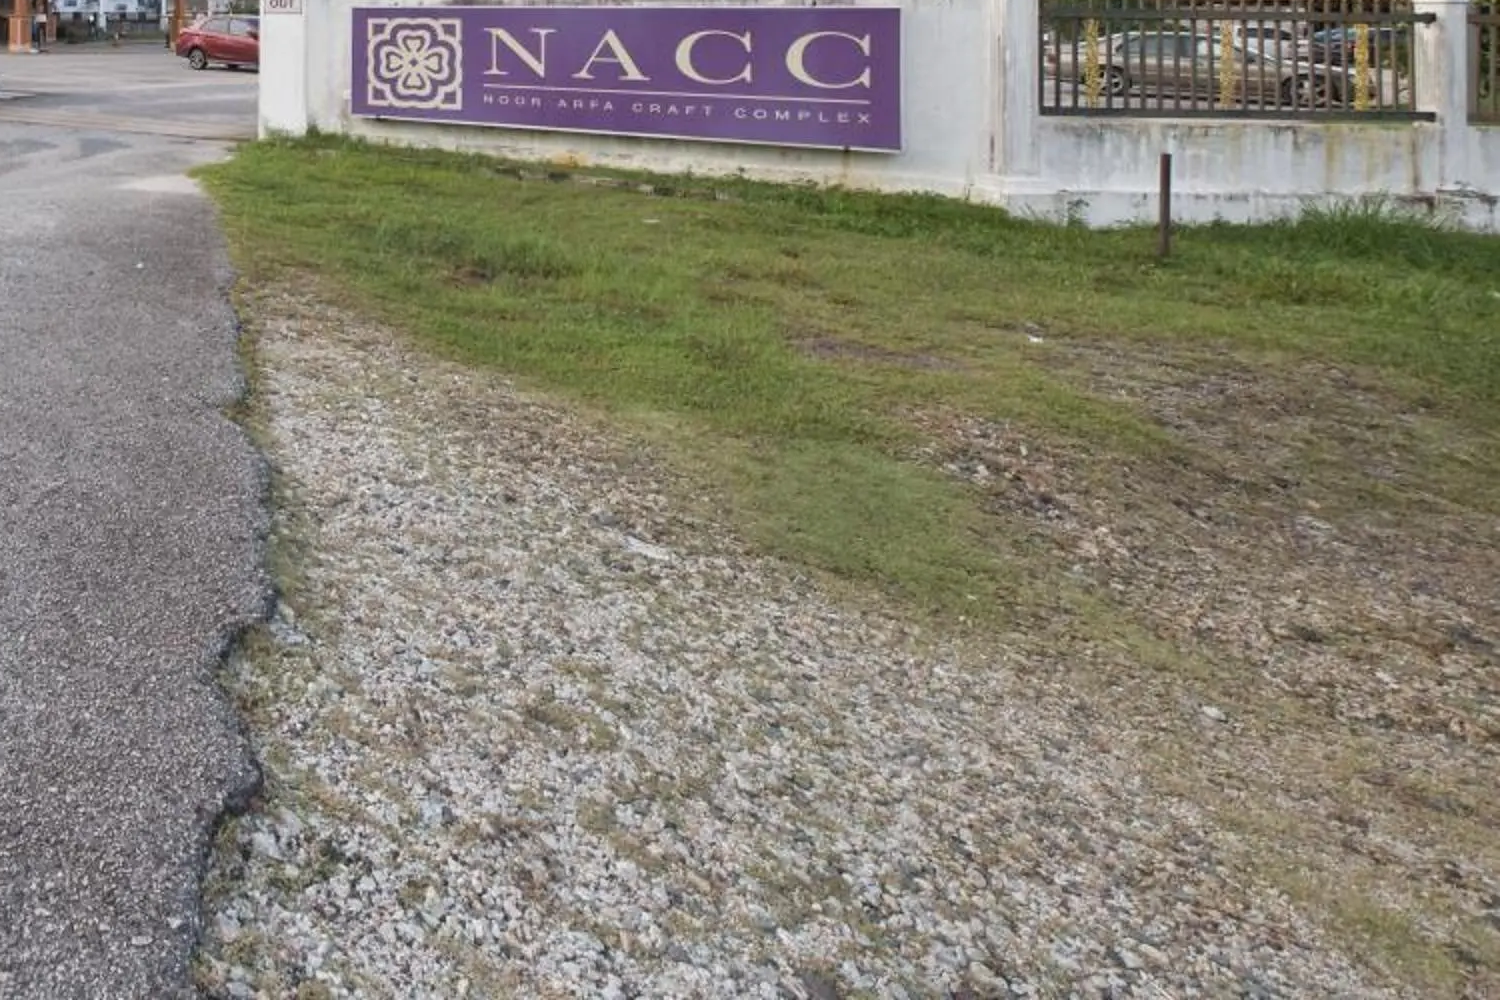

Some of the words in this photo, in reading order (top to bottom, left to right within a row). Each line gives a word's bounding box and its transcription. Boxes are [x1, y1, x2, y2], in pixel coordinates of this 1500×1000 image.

[483, 27, 872, 89] NACC
[483, 94, 541, 107] NOOR
[557, 98, 614, 111] ARFA
[631, 102, 713, 116] CRAFT
[733, 106, 871, 124] COMPLEX
